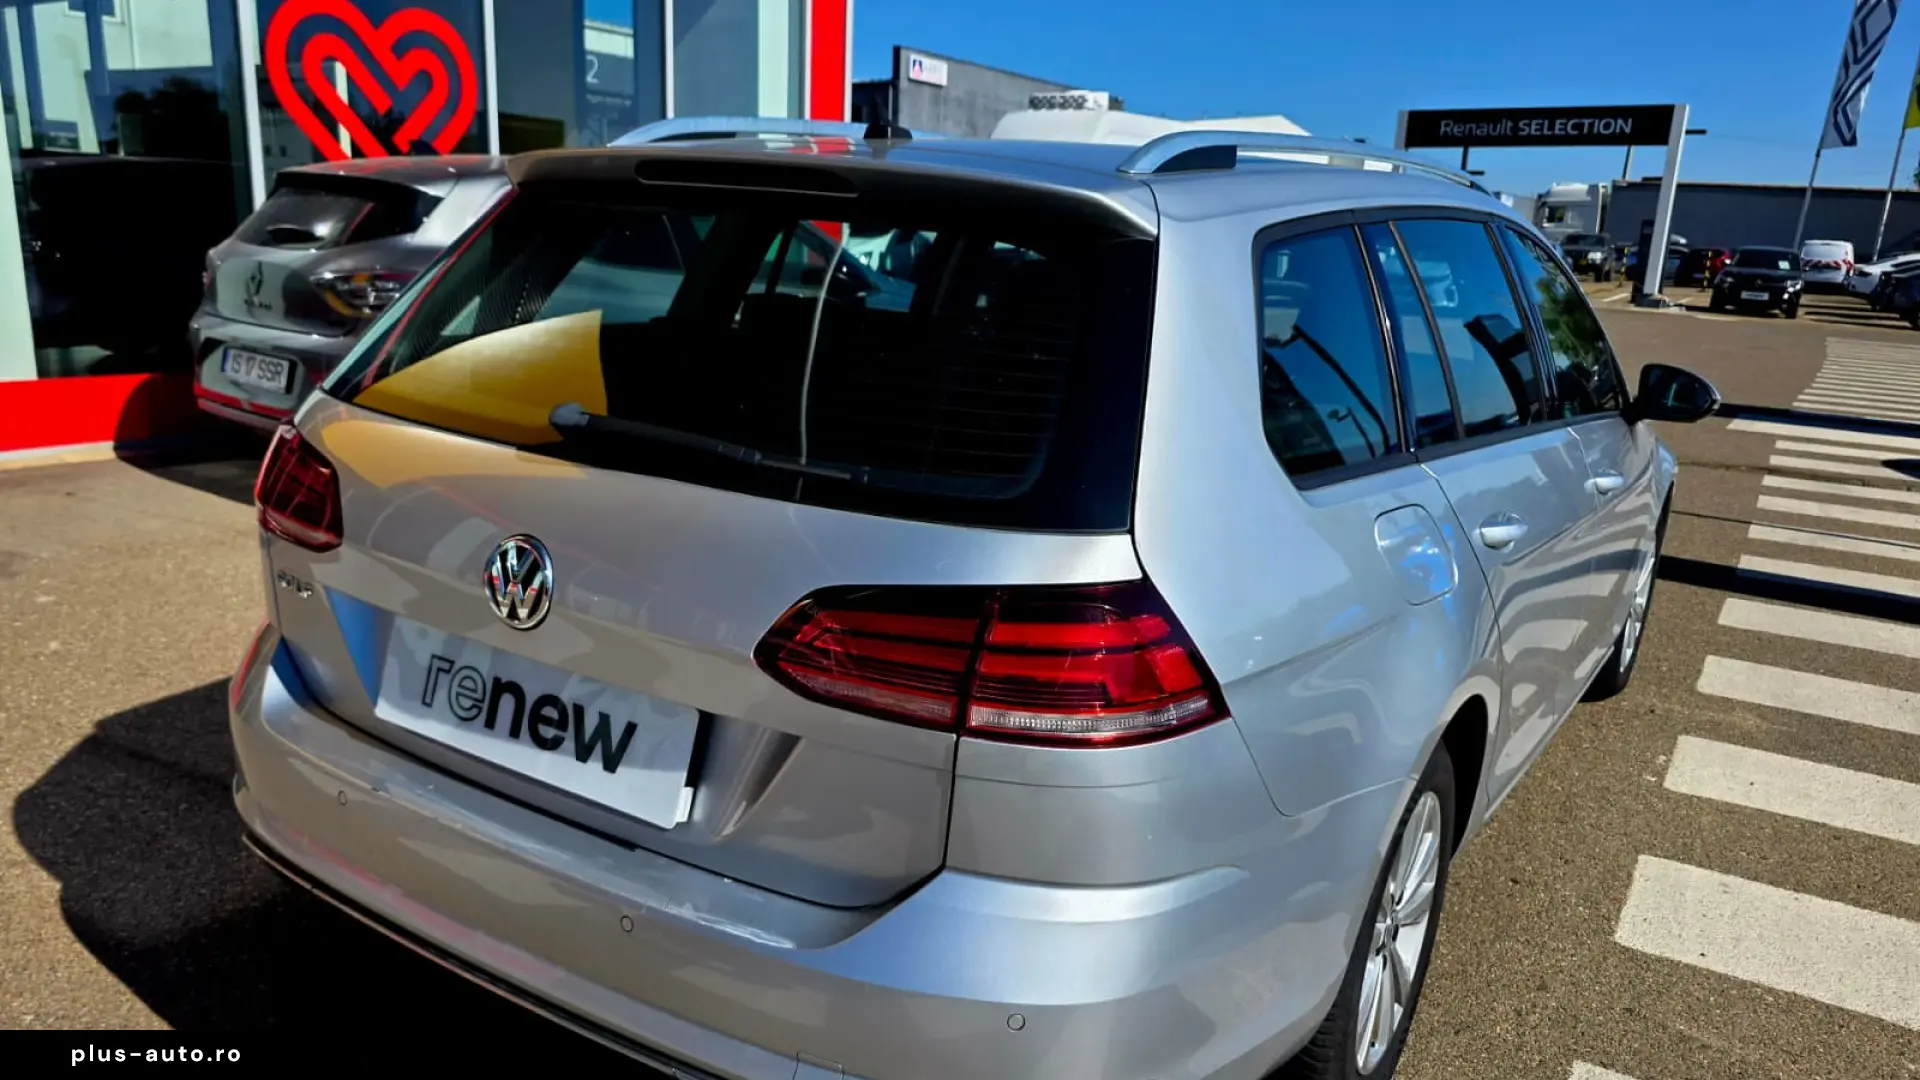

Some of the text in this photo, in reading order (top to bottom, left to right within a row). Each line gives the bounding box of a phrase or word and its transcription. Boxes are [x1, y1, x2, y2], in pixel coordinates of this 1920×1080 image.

[1439, 118, 1633, 137] Renault SELECTION
[257, 359, 285, 384] SSR
[421, 654, 638, 774] renew
